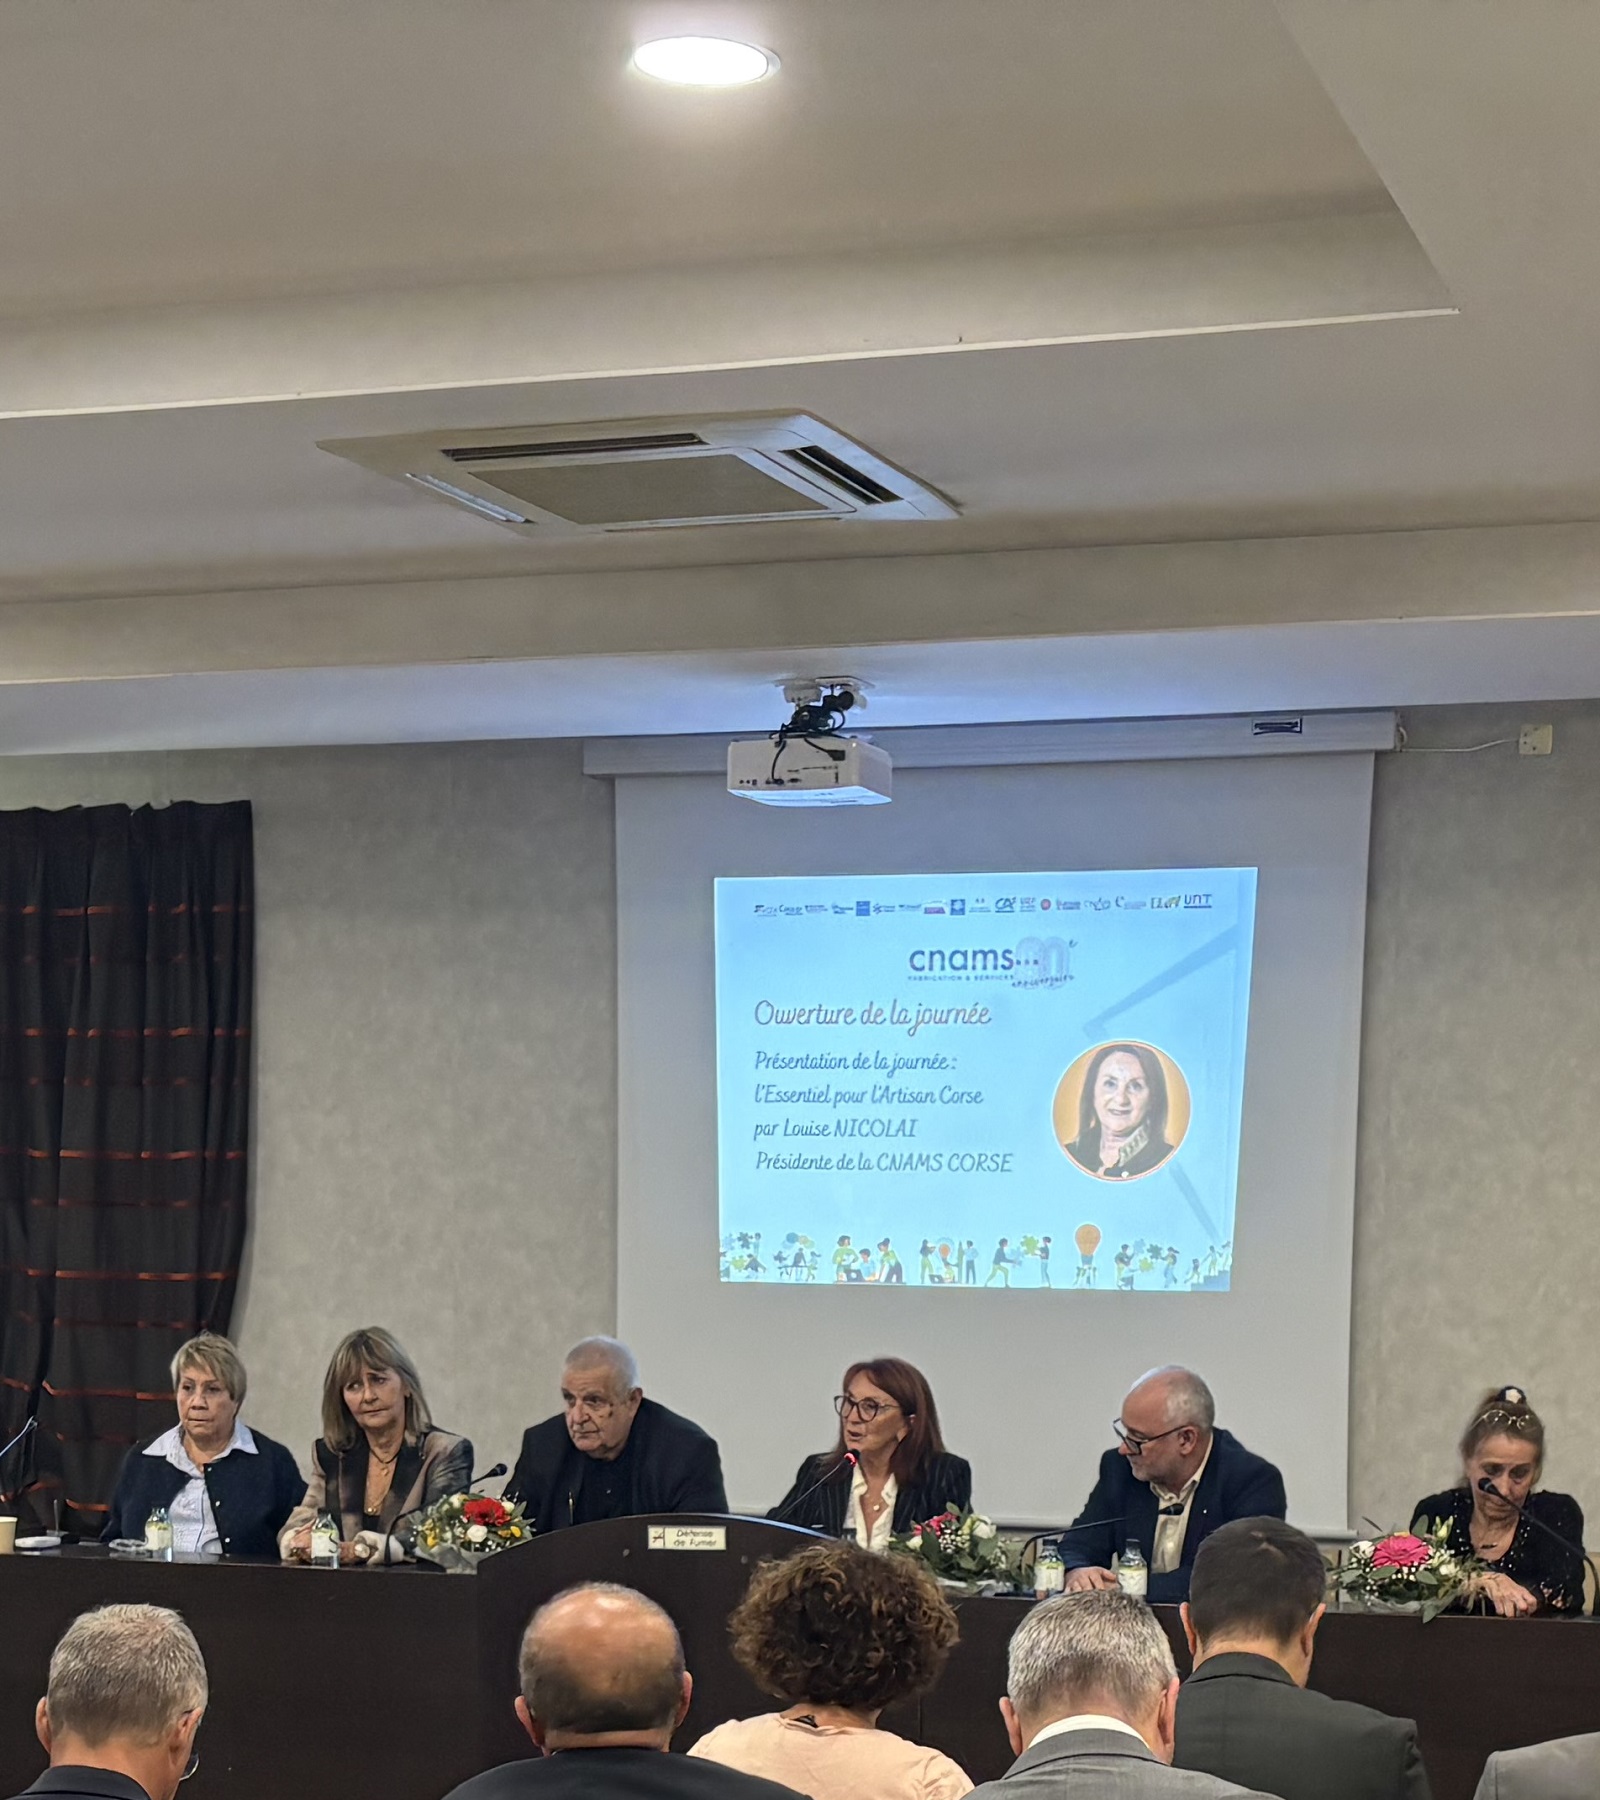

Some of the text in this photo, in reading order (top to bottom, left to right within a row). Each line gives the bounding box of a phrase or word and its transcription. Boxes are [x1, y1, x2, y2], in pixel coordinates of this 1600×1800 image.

[909, 948, 1015, 972] cnams
[754, 998, 993, 1037] Ouverture de la journée
[754, 1051, 850, 1071] Présentation
[851, 1051, 872, 1070] de
[873, 1050, 891, 1070] la
[754, 1083, 984, 1109] l'Essentiel pour l'Artisan Corse
[753, 1118, 919, 1142] par Louise NICOLAI
[755, 1151, 1014, 1173] Présidente de la CNAMS CORSE
